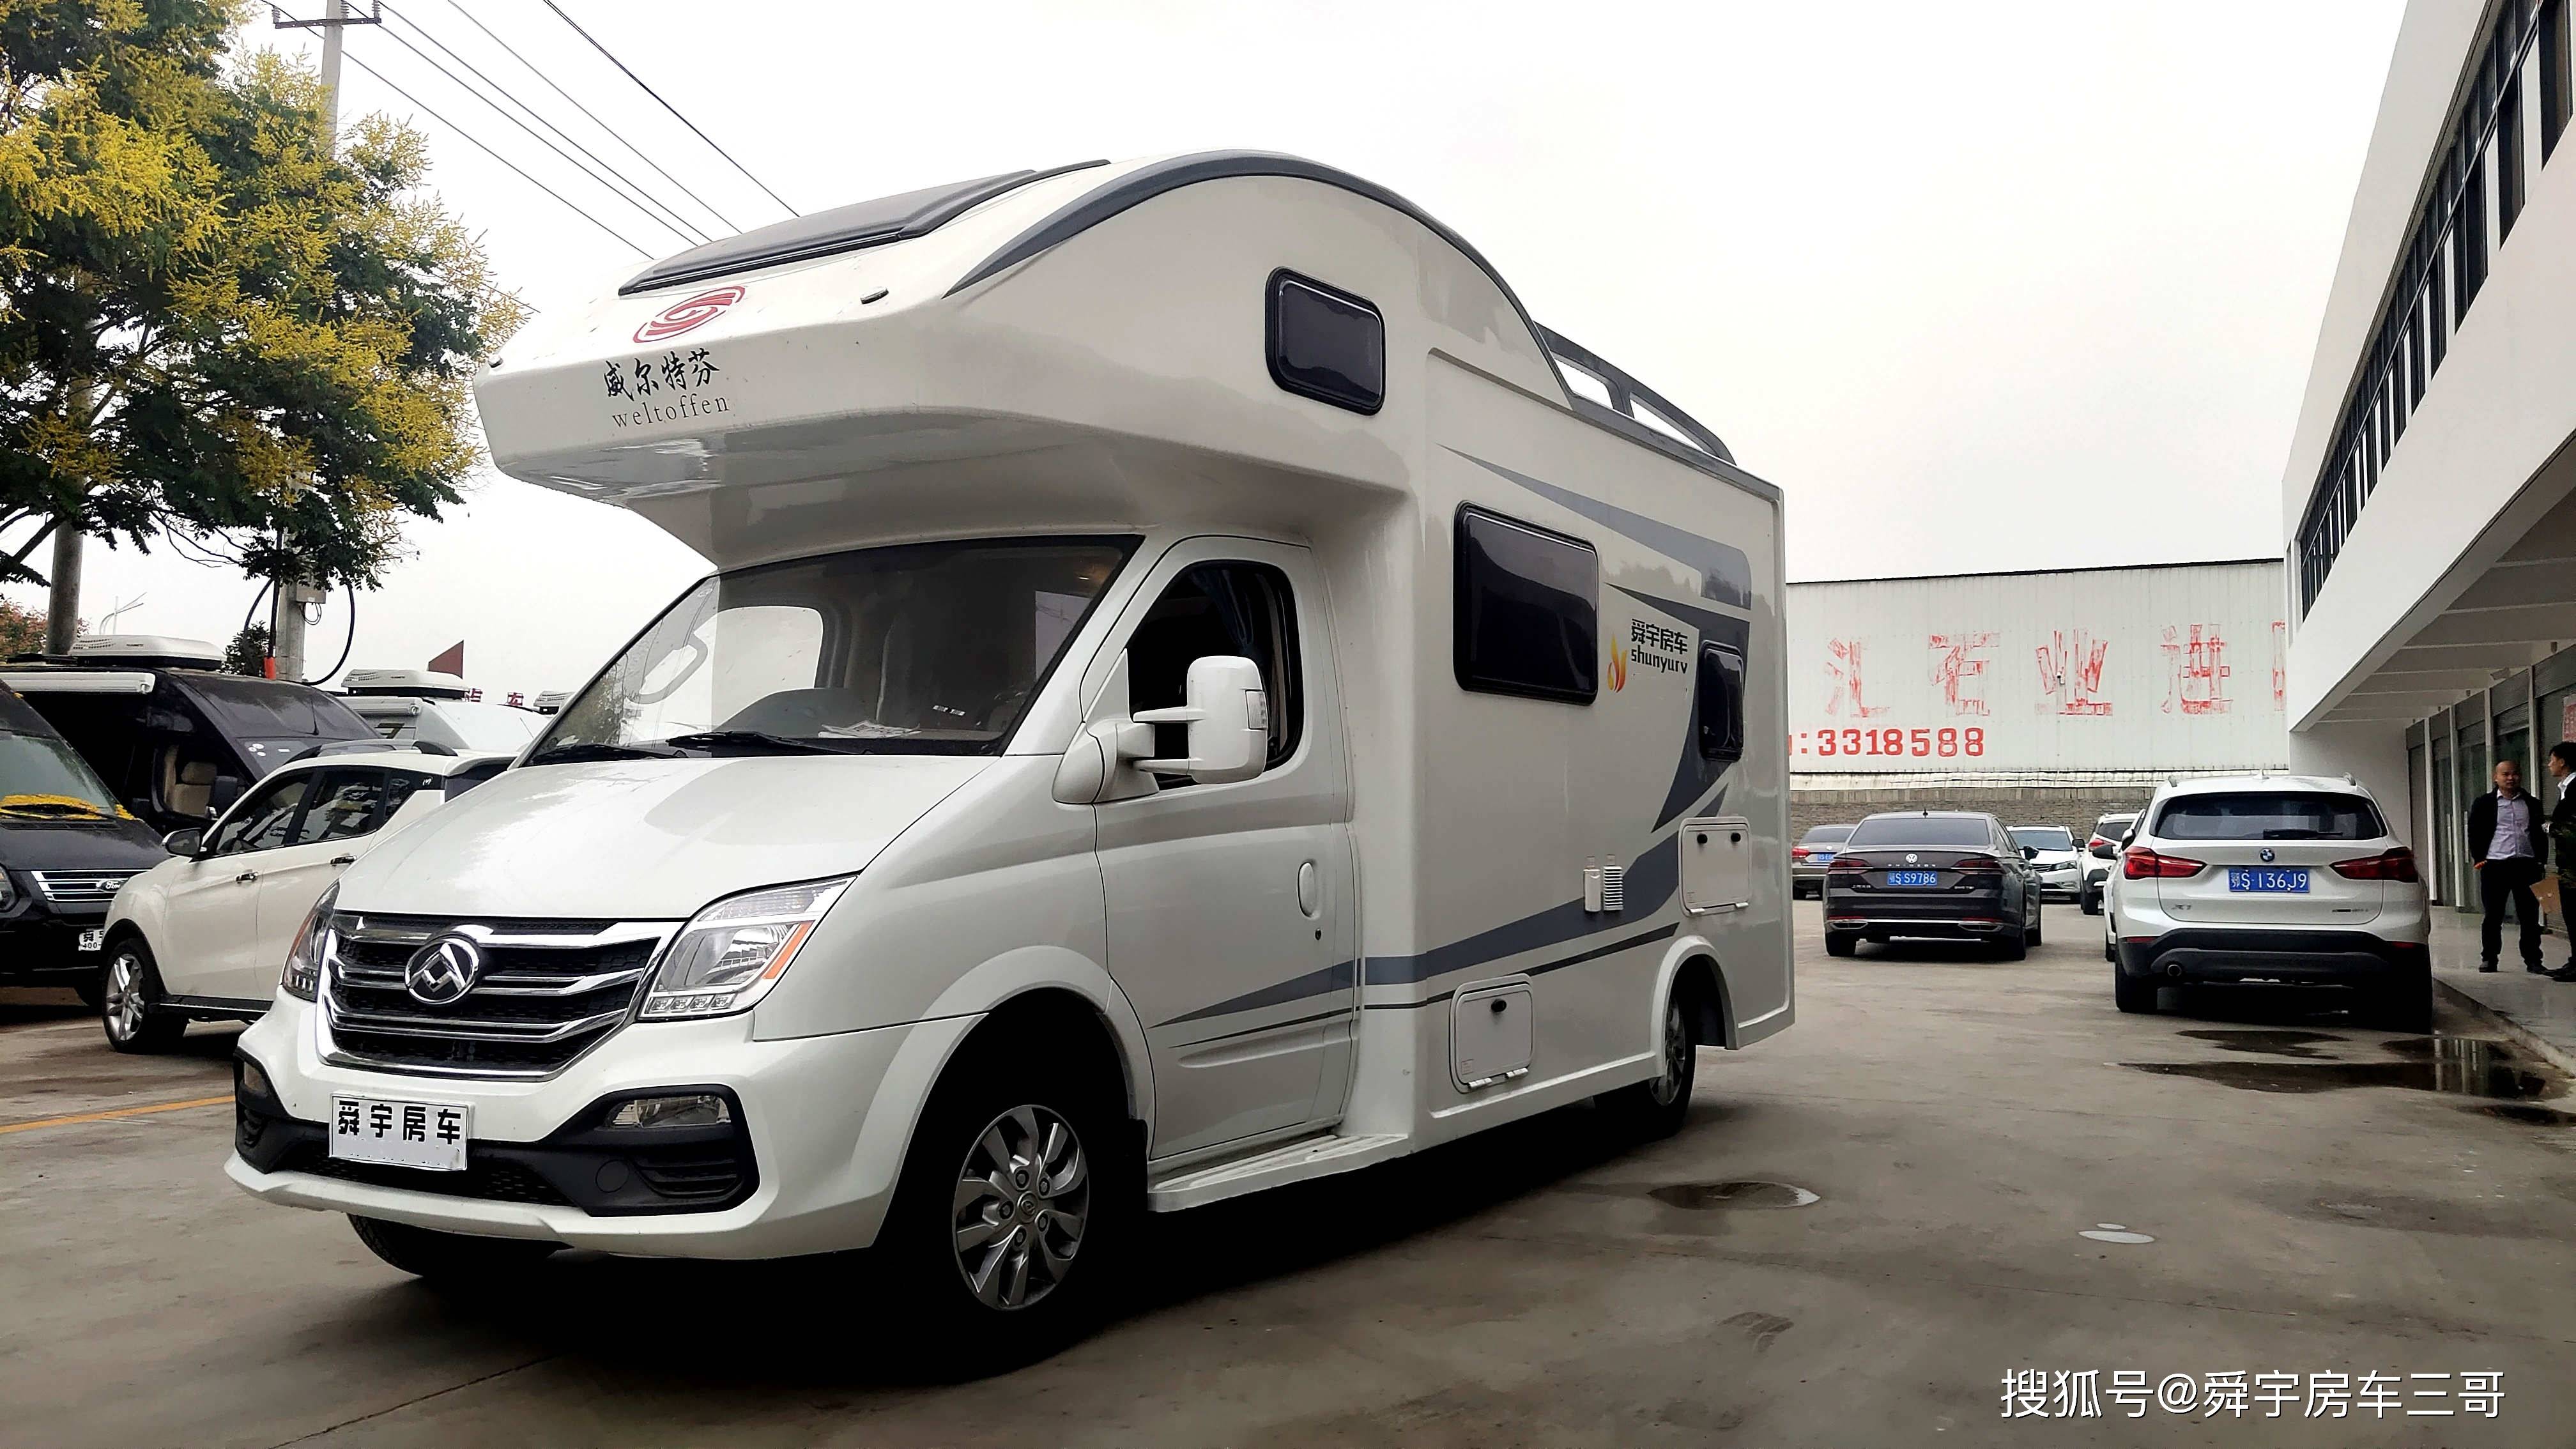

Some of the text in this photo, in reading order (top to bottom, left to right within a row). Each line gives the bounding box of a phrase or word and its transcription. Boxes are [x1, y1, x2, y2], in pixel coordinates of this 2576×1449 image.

[604, 348, 720, 401] 威尔特芬
[612, 394, 730, 427] weltoffen
[1631, 618, 1688, 654] 舜宇房车
[1631, 645, 1688, 674] shunyurv
[1788, 727, 1984, 756] :3318588
[338, 1100, 461, 1145] 舜宇房车
